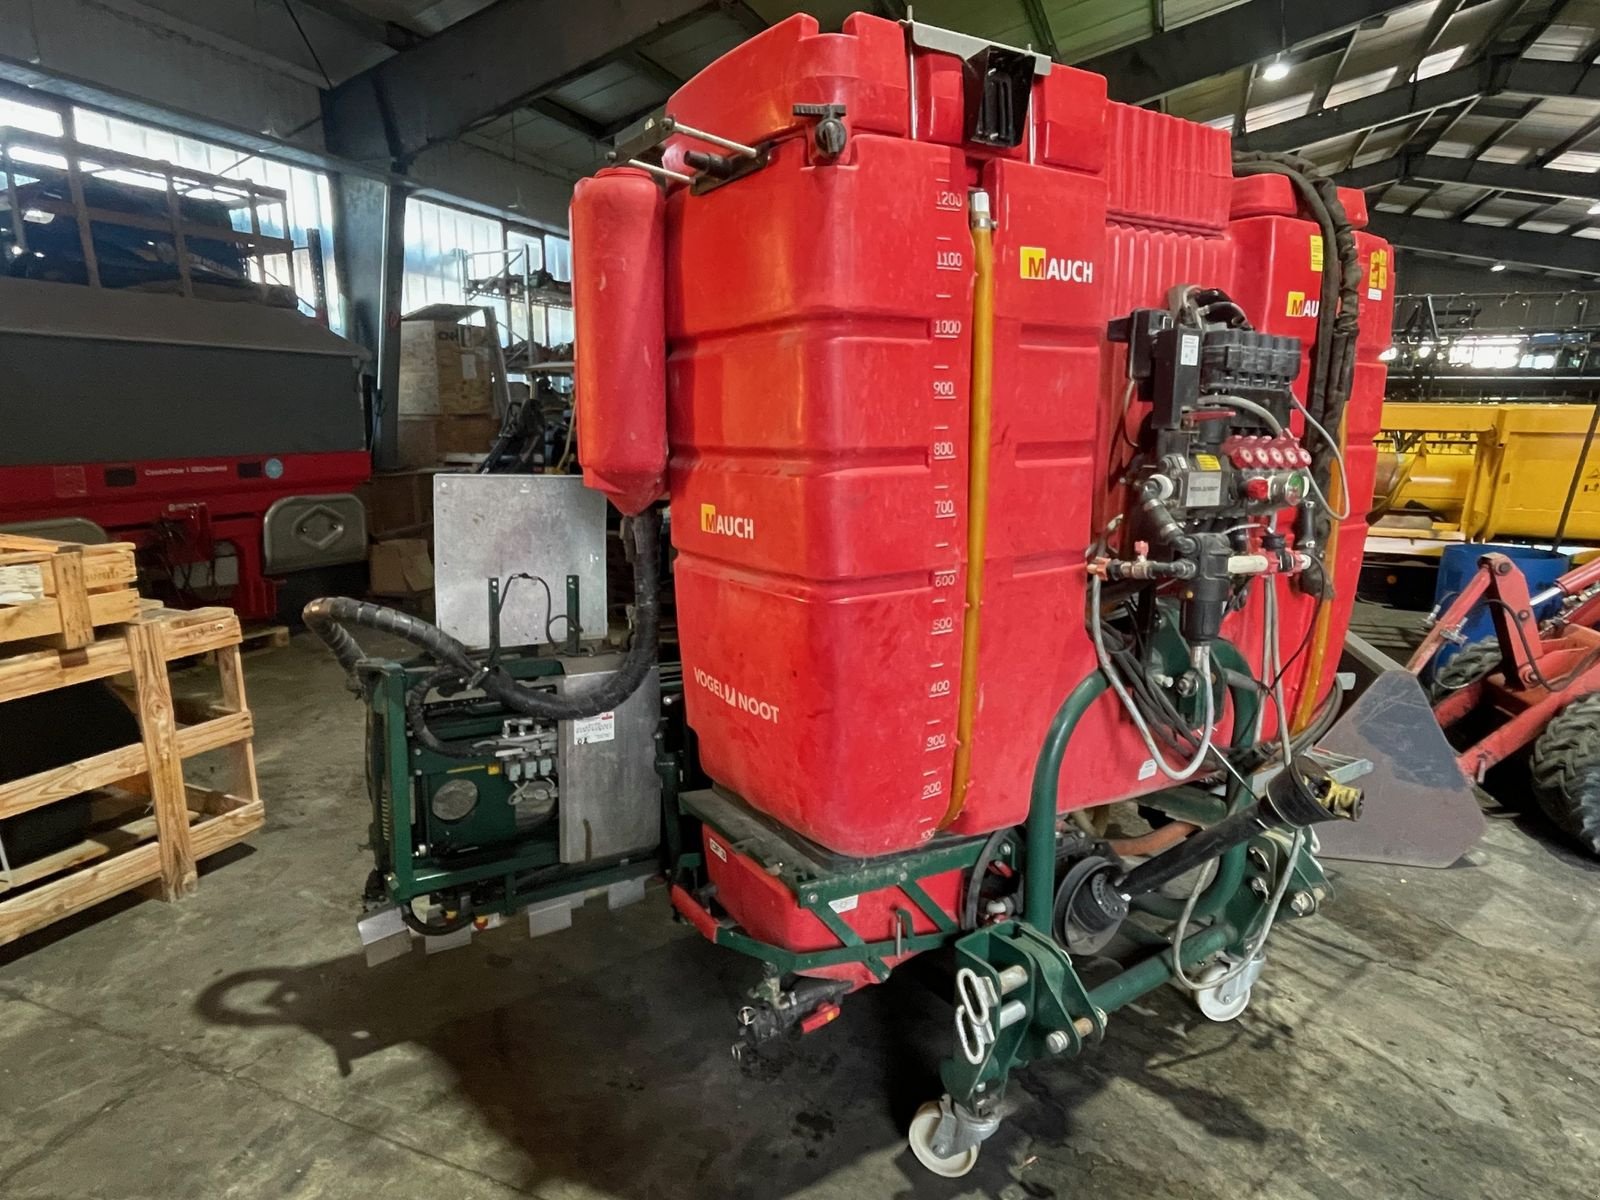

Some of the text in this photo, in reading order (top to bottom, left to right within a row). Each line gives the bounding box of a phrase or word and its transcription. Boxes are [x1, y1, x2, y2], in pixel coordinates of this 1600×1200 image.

[936, 191, 963, 207] 1200
[936, 251, 963, 267] 1100
[1028, 256, 1093, 284] MAUCH
[1291, 299, 1320, 318] MAU
[935, 319, 962, 334] 1000
[933, 381, 955, 395] 900
[933, 442, 953, 455] 800
[934, 500, 954, 514] 700
[705, 512, 754, 540] MAUCH
[935, 574, 956, 588] 600
[932, 616, 953, 630] 500
[930, 680, 950, 693] 400
[693, 666, 780, 724] VOGEL NOOT
[926, 733, 946, 747] 300
[922, 781, 942, 796] 200
